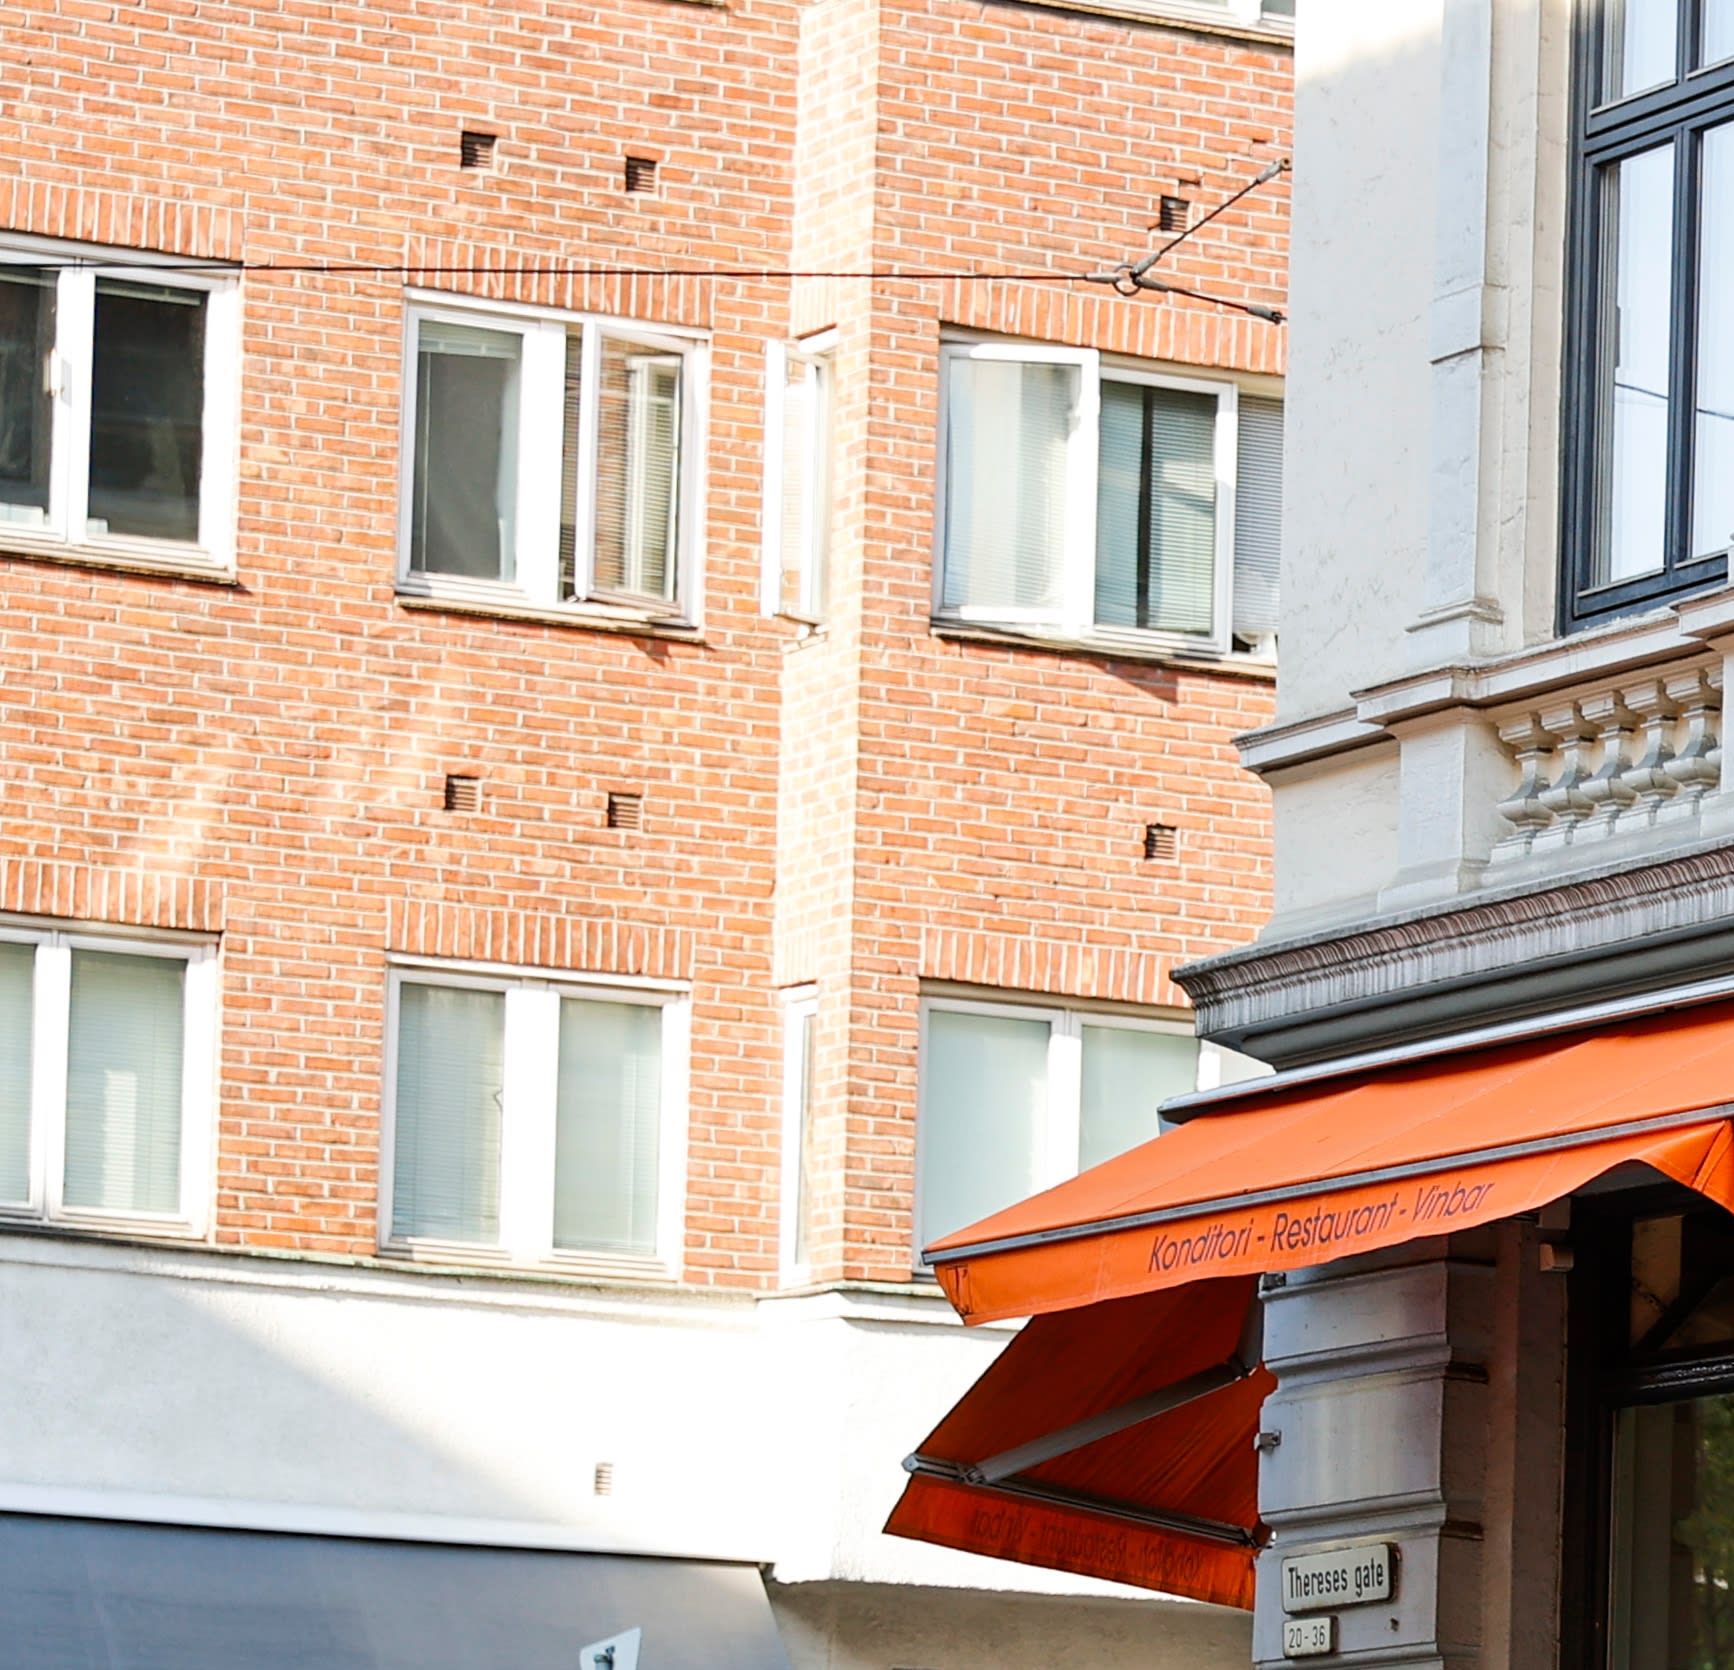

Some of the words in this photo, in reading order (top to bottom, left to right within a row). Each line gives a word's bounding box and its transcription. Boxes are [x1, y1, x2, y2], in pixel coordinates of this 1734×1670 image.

[1147, 1218, 1253, 1273] Konditori
[1270, 1193, 1397, 1253] Restaurant
[1410, 1180, 1497, 1223] Vinbar
[1288, 1565, 1348, 1598] Thereses
[1354, 1558, 1384, 1598] gate
